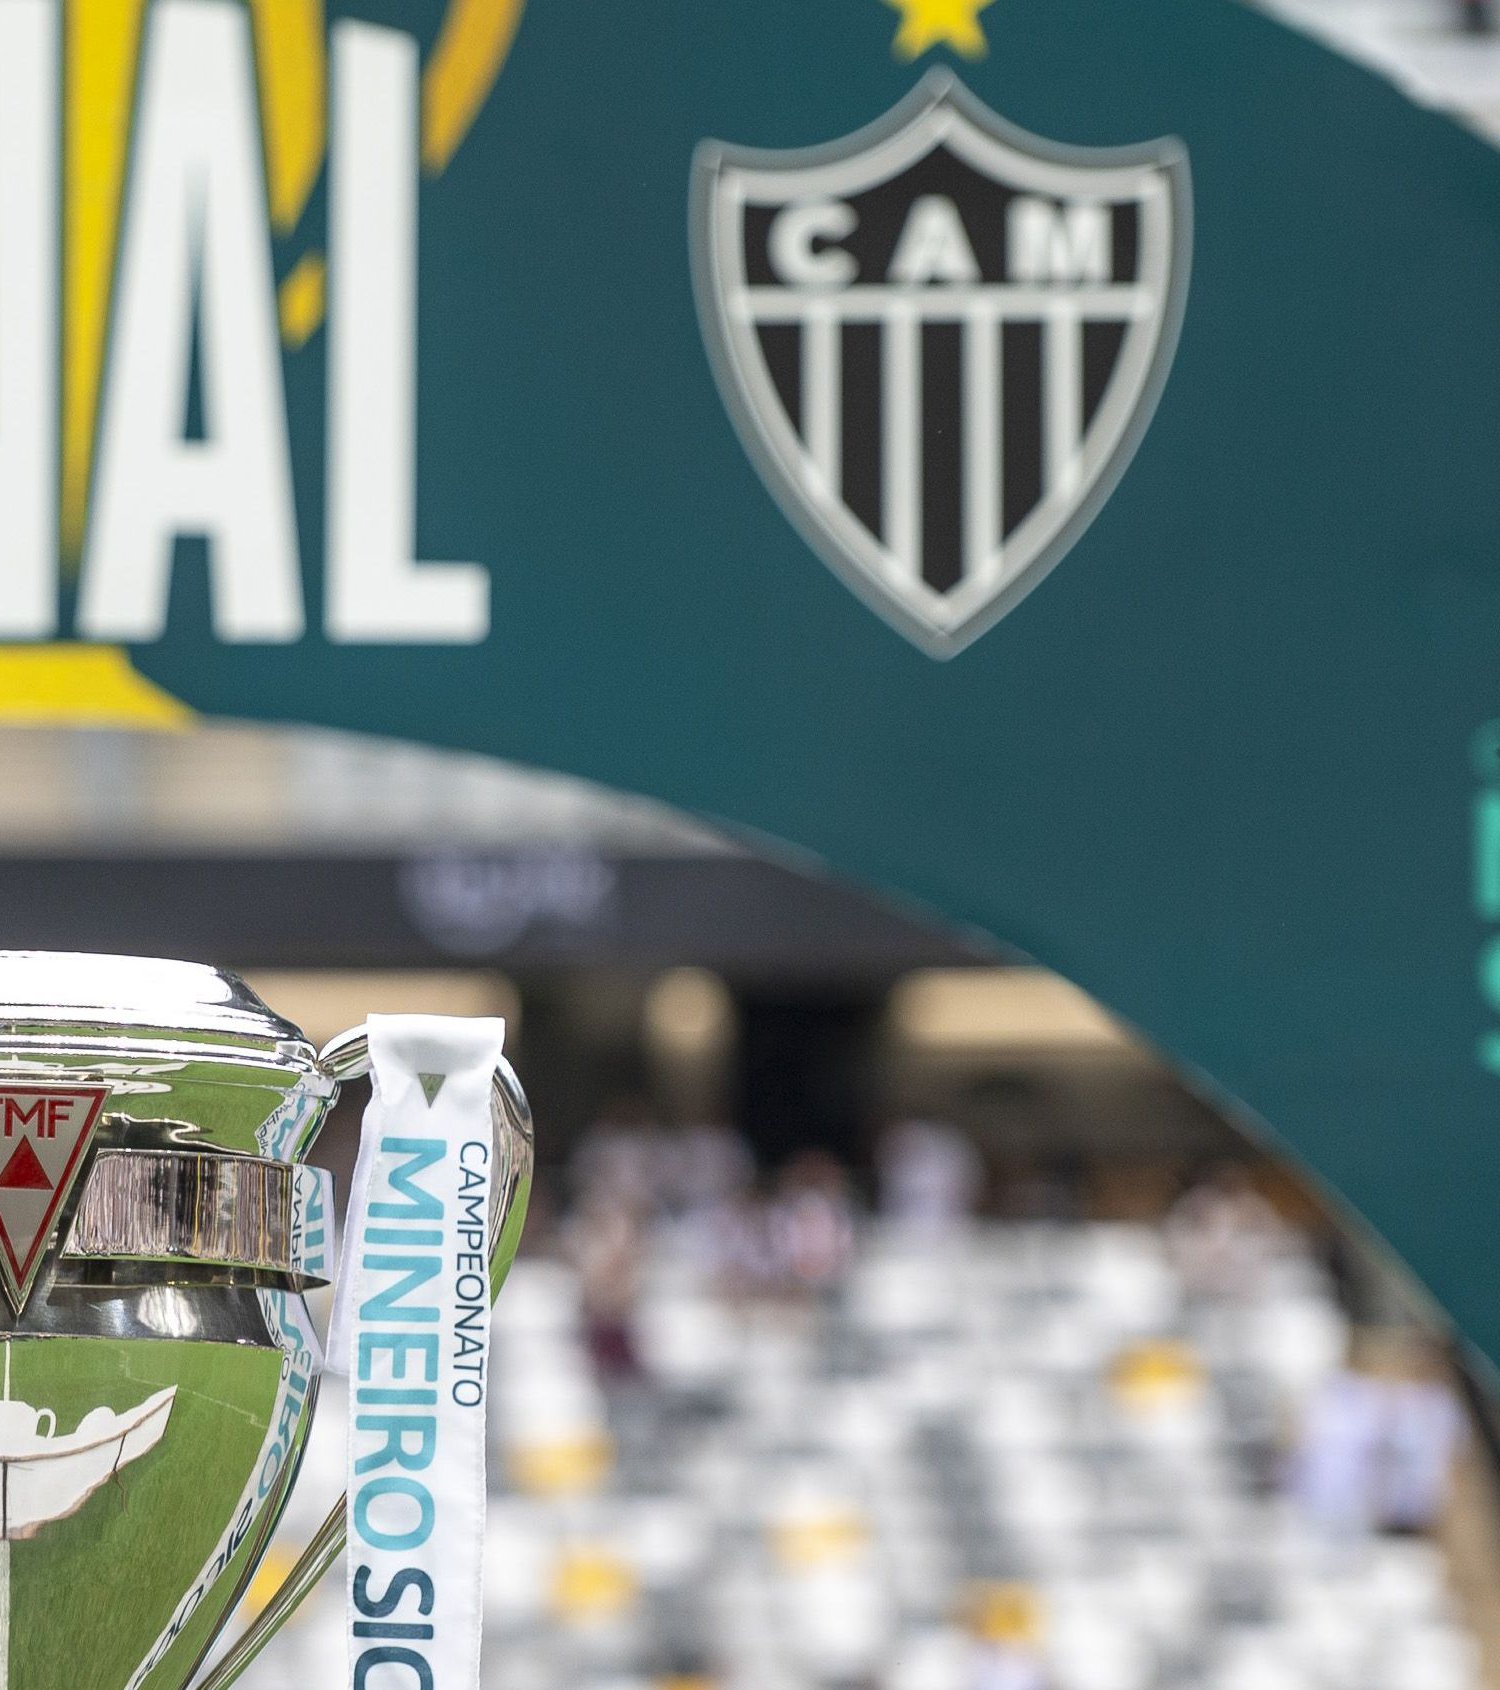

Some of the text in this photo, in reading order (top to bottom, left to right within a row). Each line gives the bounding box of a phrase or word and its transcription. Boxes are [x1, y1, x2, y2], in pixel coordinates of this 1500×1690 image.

[766, 197, 1114, 286] CAM
[353, 1136, 447, 1551] MINEIRO
[452, 1141, 488, 1407] CAMPEONATO
